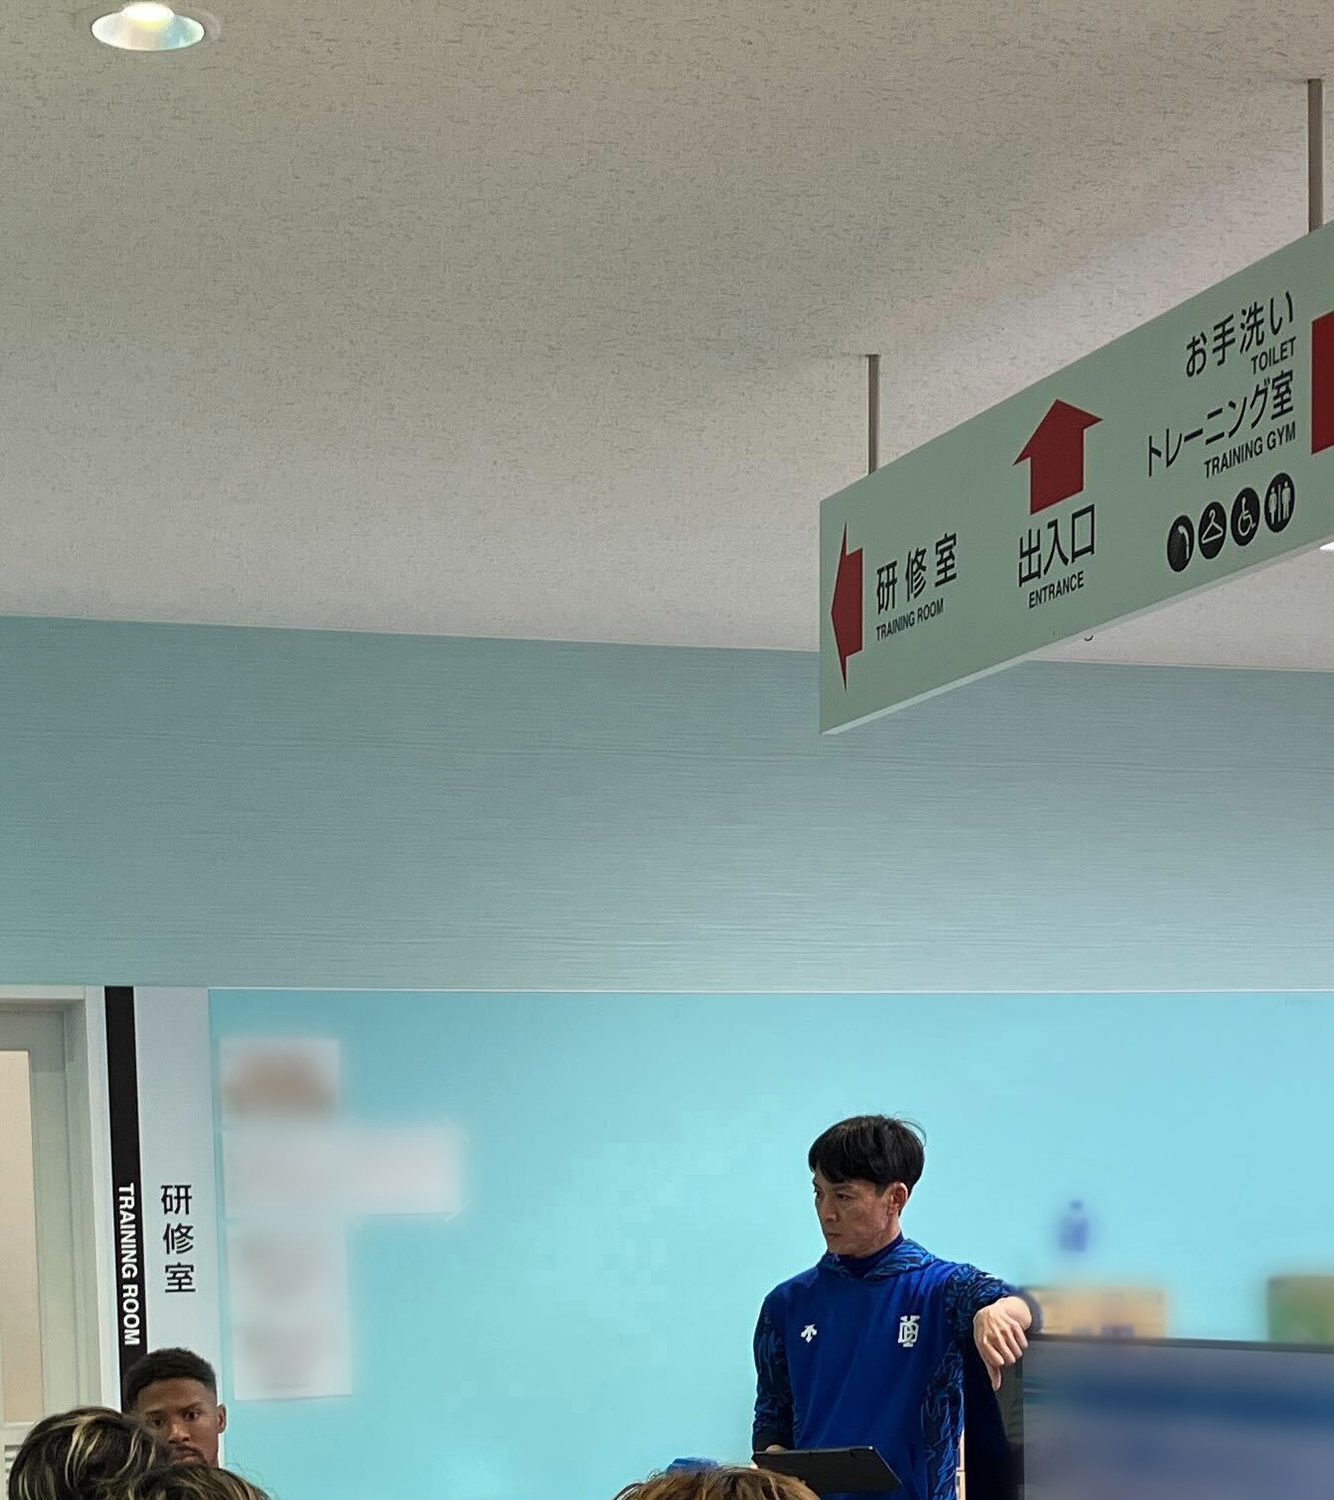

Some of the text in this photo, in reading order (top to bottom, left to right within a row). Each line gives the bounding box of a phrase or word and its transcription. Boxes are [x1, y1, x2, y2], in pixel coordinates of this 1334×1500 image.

[1185, 291, 1294, 378] お手洗い
[1250, 336, 1297, 375] TOILET
[1148, 369, 1294, 478] トレーニング室
[1204, 420, 1296, 479] TRAINING GYM
[876, 532, 958, 615] 研修室
[1018, 503, 1095, 588] 出入口
[875, 597, 945, 642] TRAINING ROOM
[1028, 570, 1085, 610] ENTRANCE
[118, 1182, 141, 1346] TRAINING ROOM
[160, 1184, 197, 1294] 研修室
